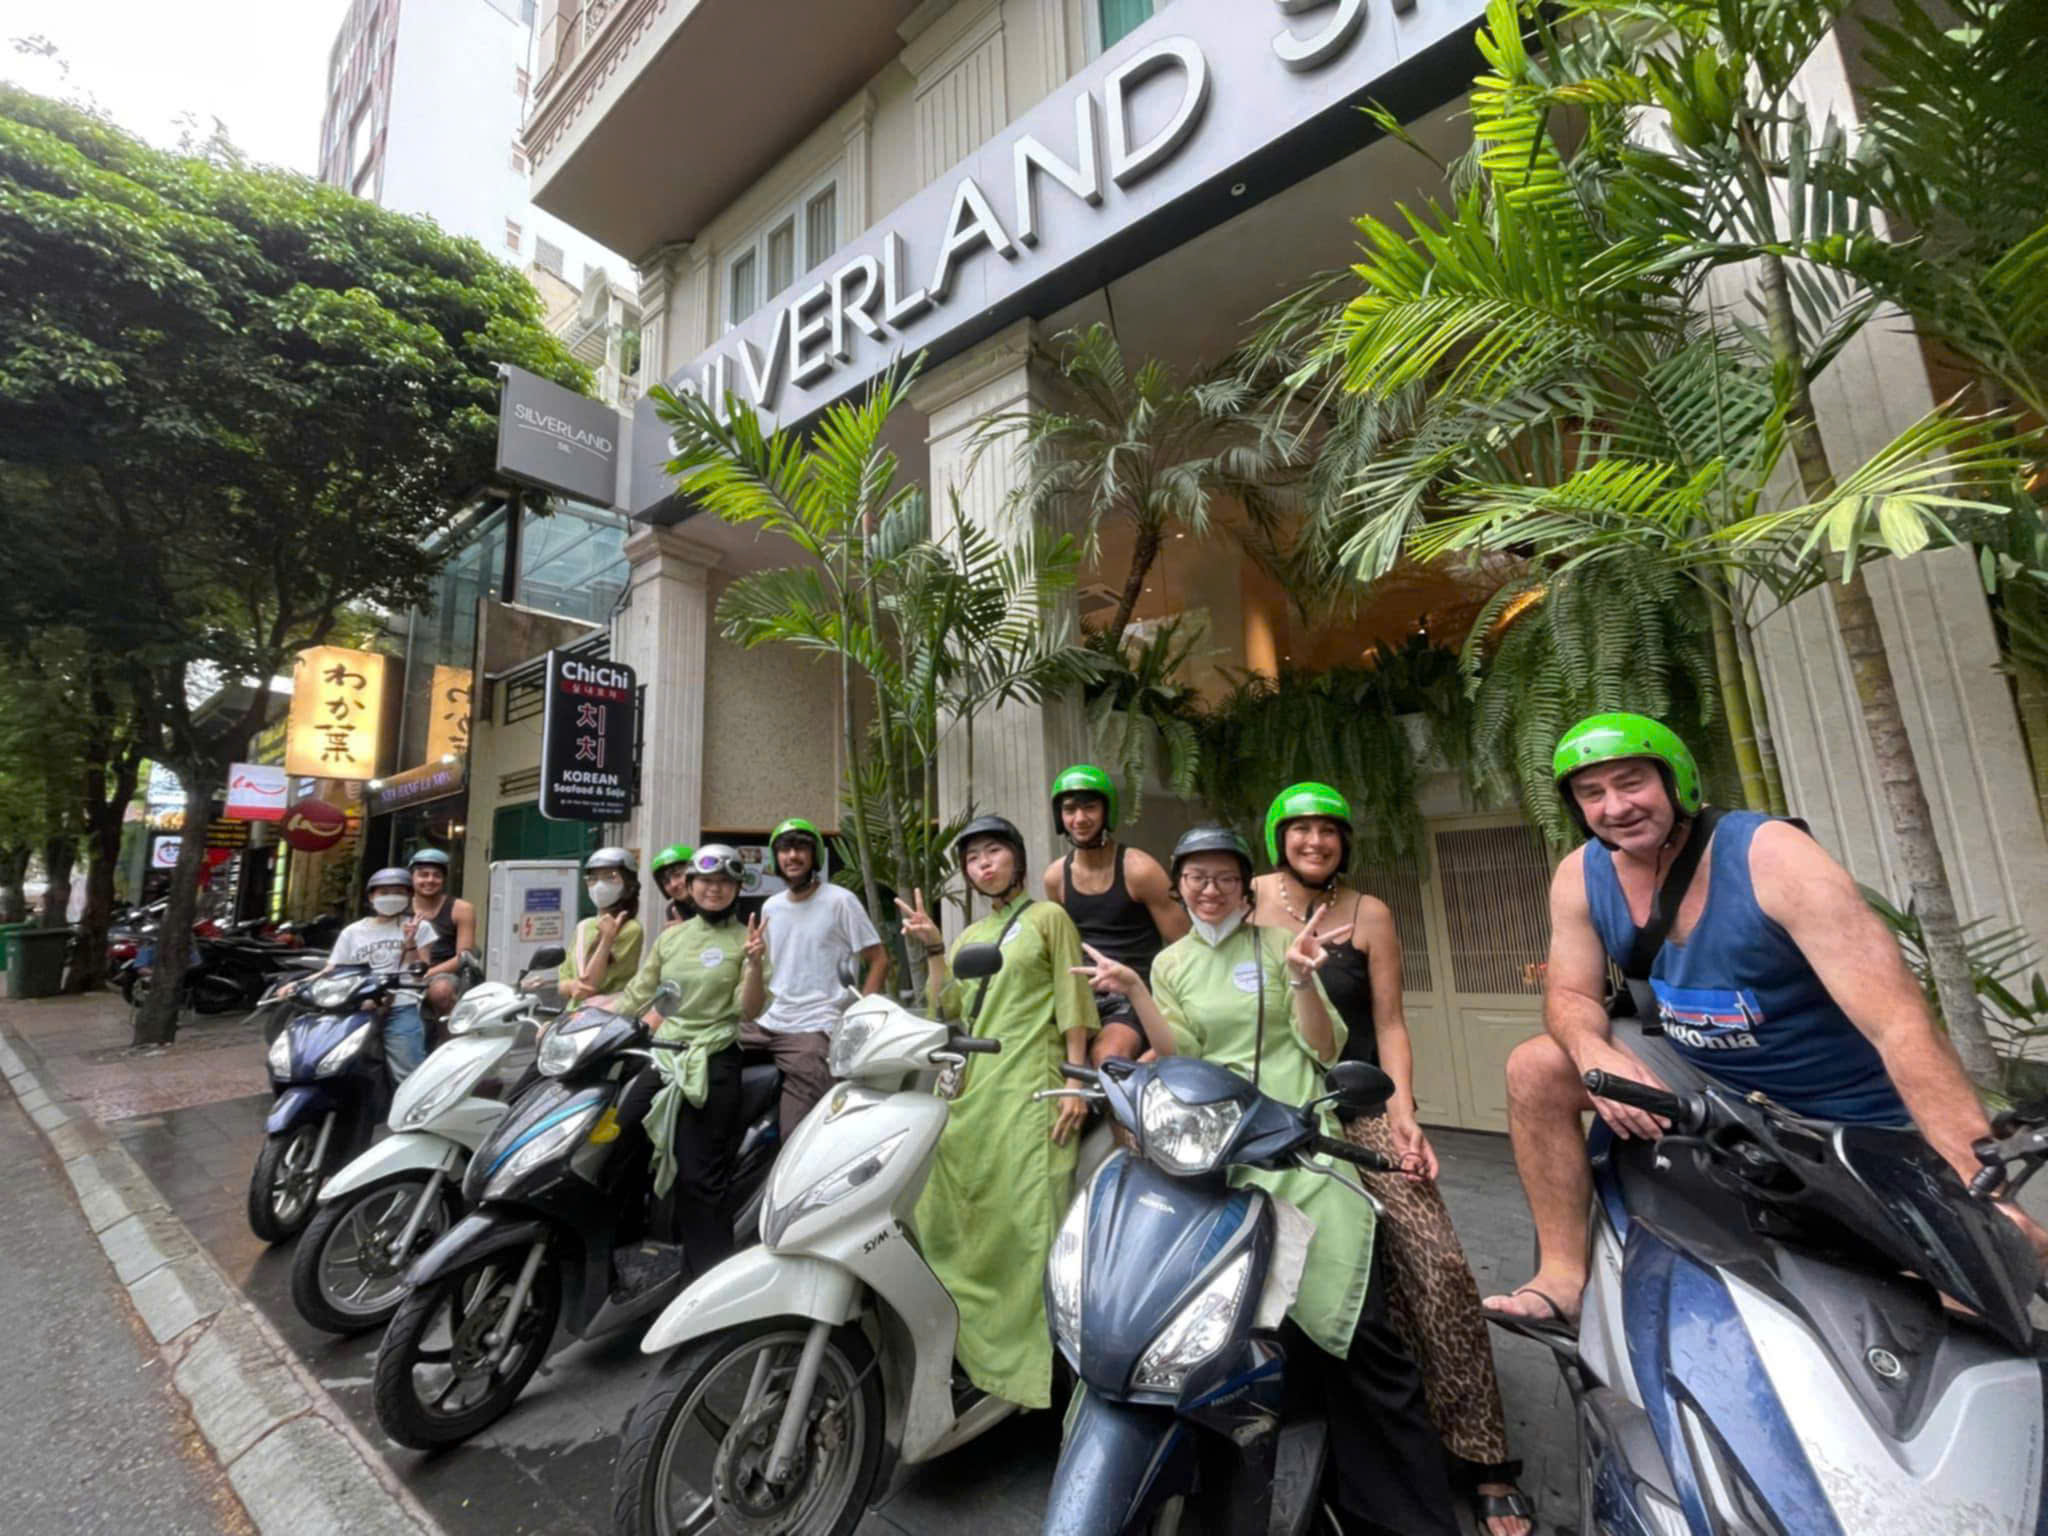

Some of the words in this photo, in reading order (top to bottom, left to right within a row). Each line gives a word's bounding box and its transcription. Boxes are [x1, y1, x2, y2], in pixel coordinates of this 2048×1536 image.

[514, 403, 612, 453] SILVERLAND
[561, 661, 629, 689] ChiChi
[553, 783, 593, 795] Seafood
[562, 770, 618, 786] KOREAN
[863, 1229, 889, 1255] SYM
